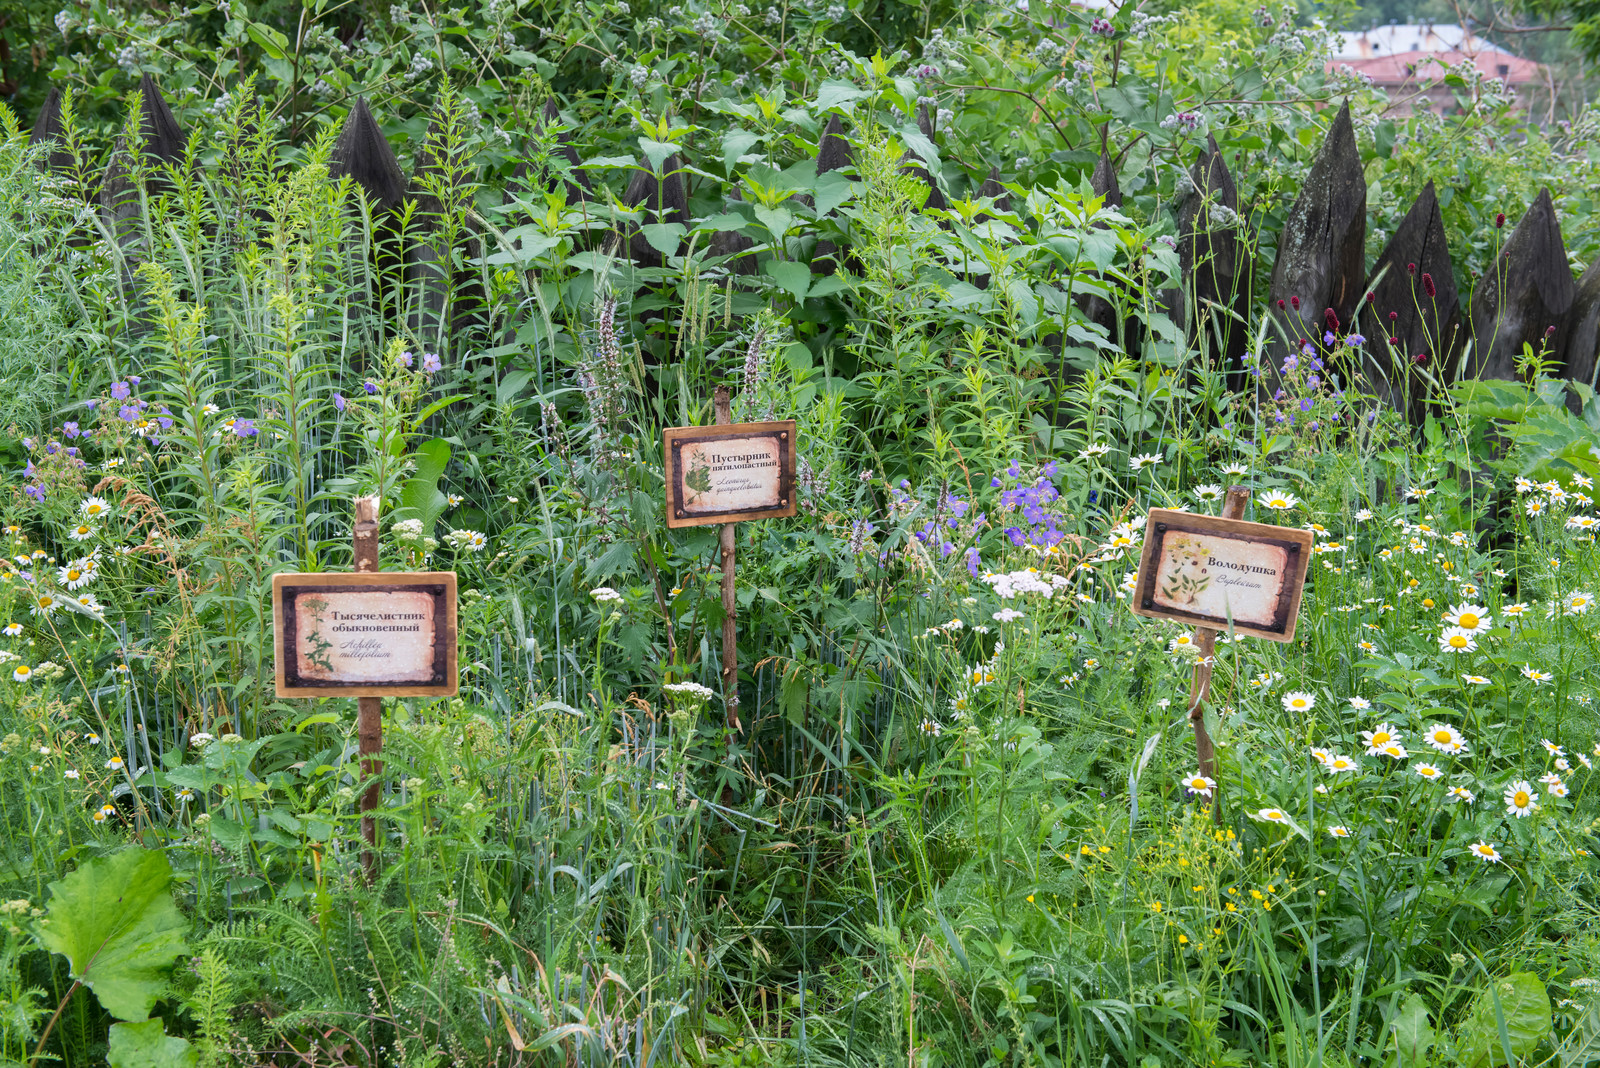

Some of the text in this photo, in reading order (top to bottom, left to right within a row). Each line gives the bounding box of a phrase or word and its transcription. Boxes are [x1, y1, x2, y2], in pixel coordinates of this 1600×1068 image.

[712, 452, 771, 465] Пустырник
[712, 460, 777, 472] пятилопастный
[1208, 556, 1276, 576] Володушка
[331, 611, 425, 620] Тысячелистник
[332, 623, 420, 632] обыкновенный
[340, 639, 383, 650] Achillea
[339, 649, 391, 661] millefolium
